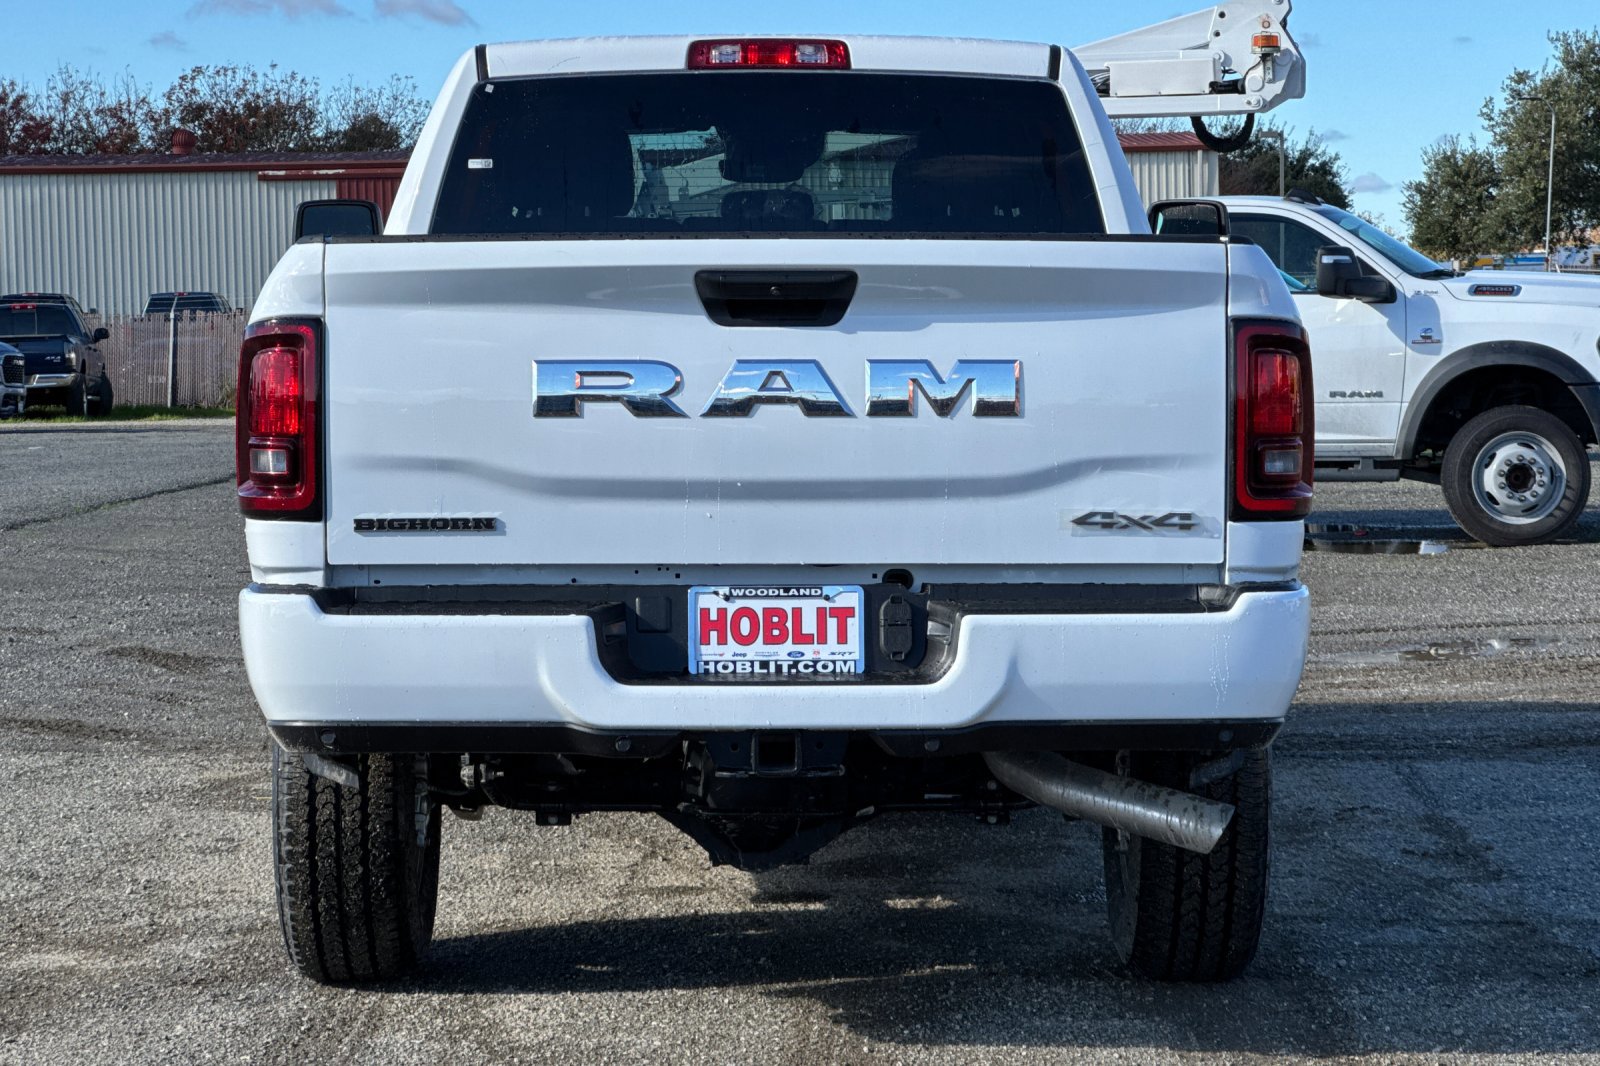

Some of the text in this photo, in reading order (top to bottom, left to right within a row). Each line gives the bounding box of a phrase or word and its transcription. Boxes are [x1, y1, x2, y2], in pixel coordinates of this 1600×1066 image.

[533, 359, 1023, 418] RAM
[1329, 390, 1384, 398] RAM
[353, 518, 497, 531] BIGHORN
[731, 588, 822, 597] WOODLAND
[700, 607, 855, 646] HOBLIT
[698, 660, 855, 674] HOBLIT.COM
